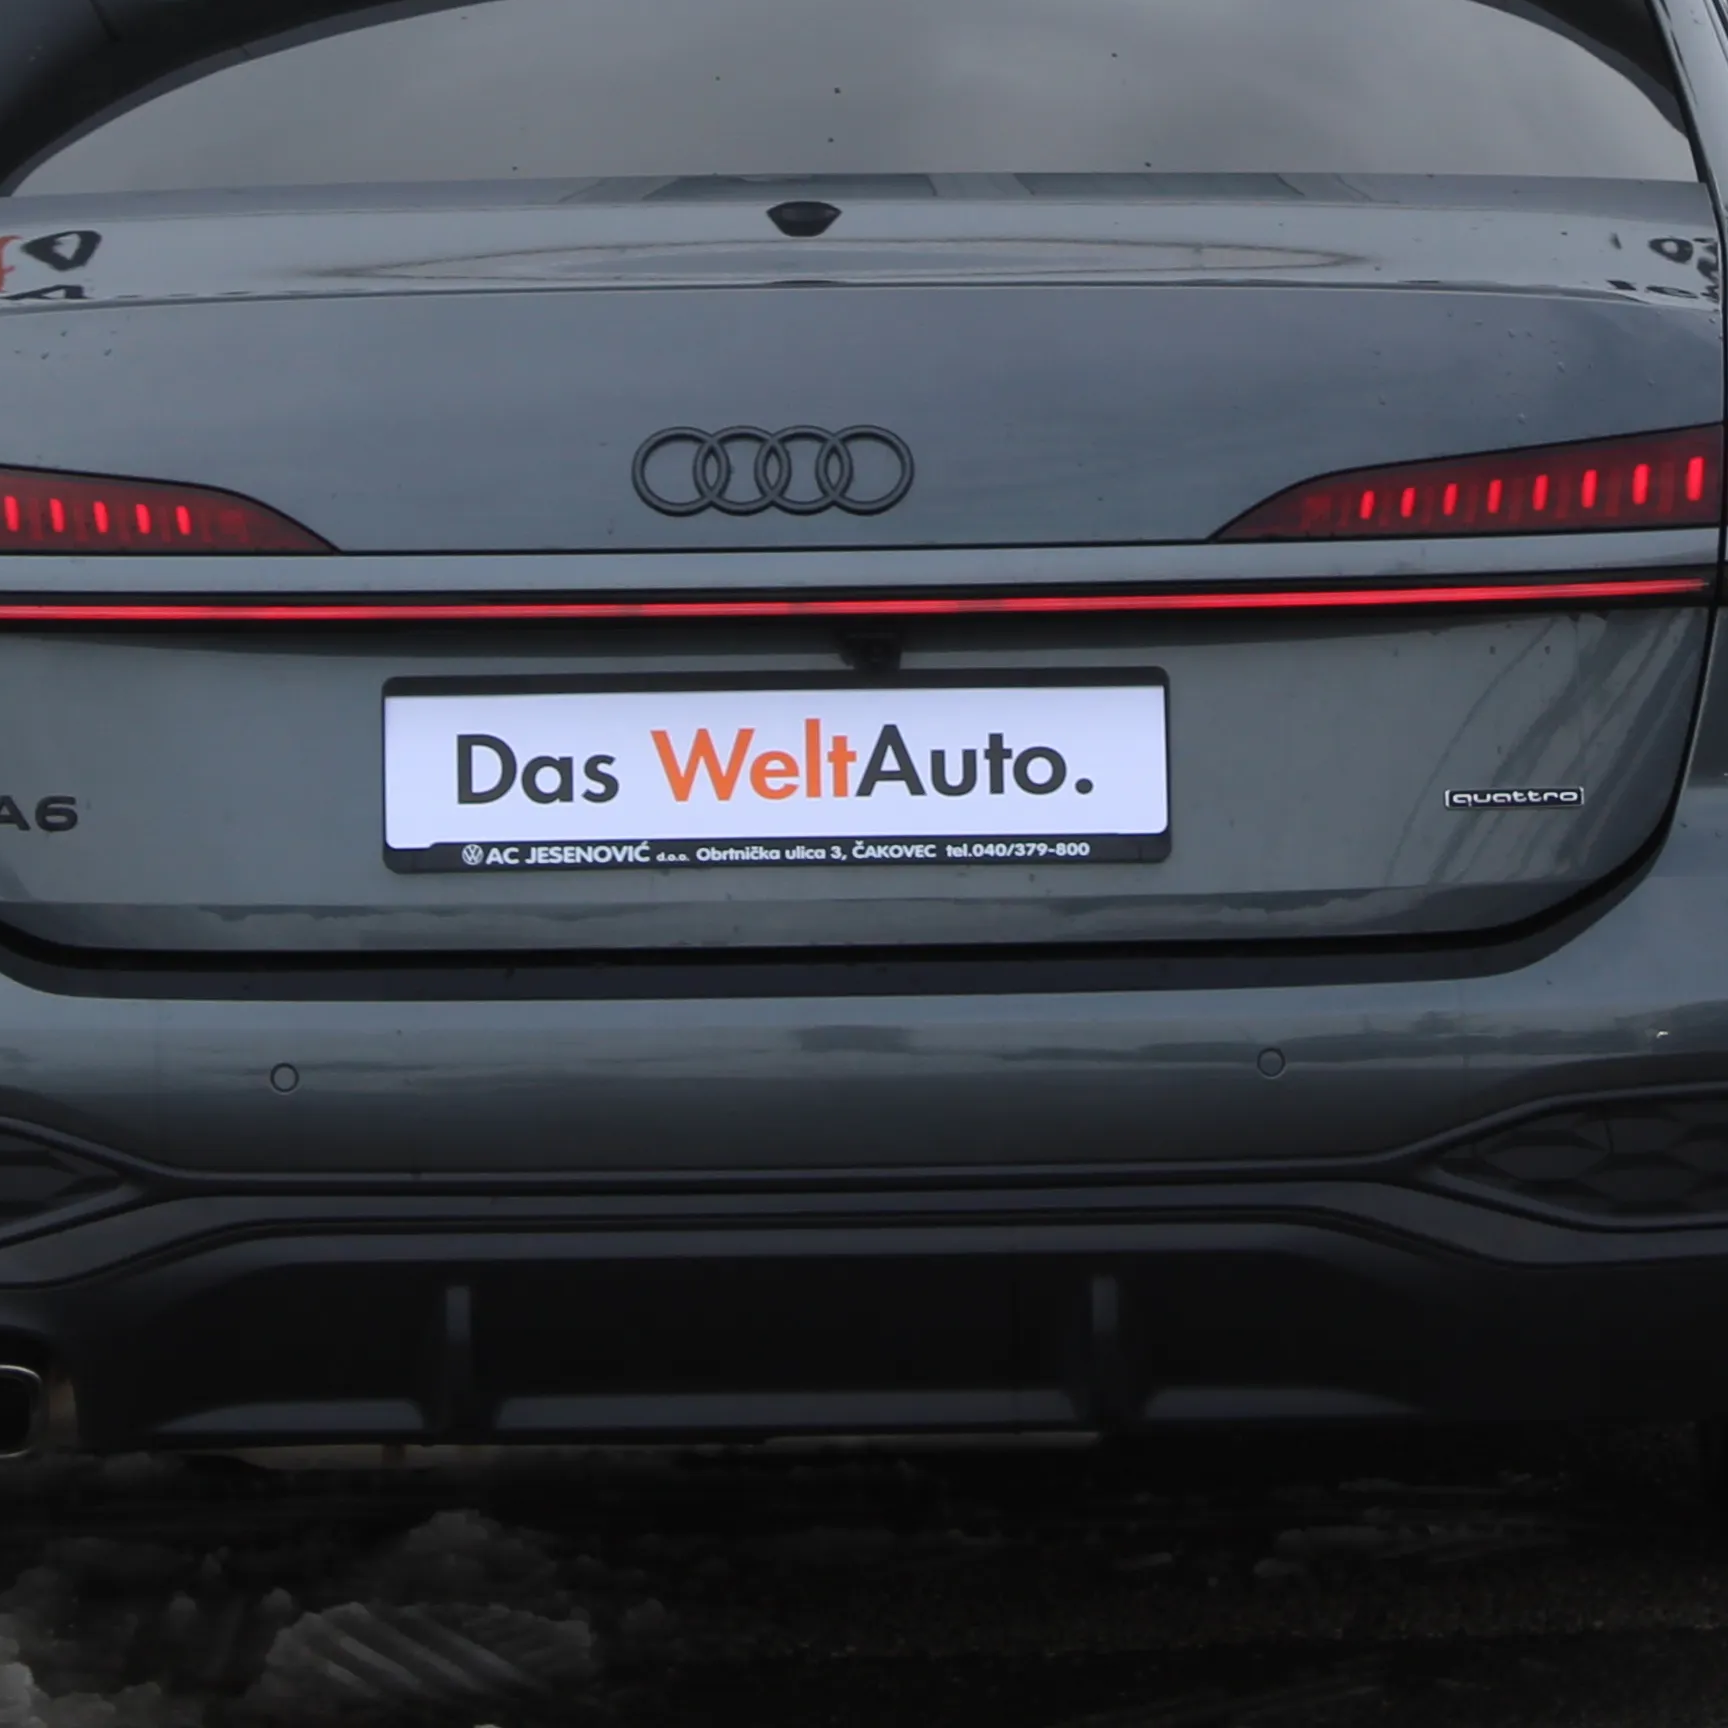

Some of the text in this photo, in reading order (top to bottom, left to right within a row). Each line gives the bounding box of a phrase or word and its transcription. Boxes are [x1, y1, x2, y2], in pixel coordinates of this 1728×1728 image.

[457, 718, 1094, 805] Das WeltAuto.
[1452, 790, 1578, 807] quattro
[485, 847, 519, 864] AC
[525, 841, 651, 864] JESENOVIĆ
[696, 845, 781, 862] Obrtnička
[785, 844, 825, 860] ulica
[830, 844, 847, 860] 3,
[852, 840, 936, 860] ČAKOVEC
[946, 841, 1091, 859] tel.040/379-800
